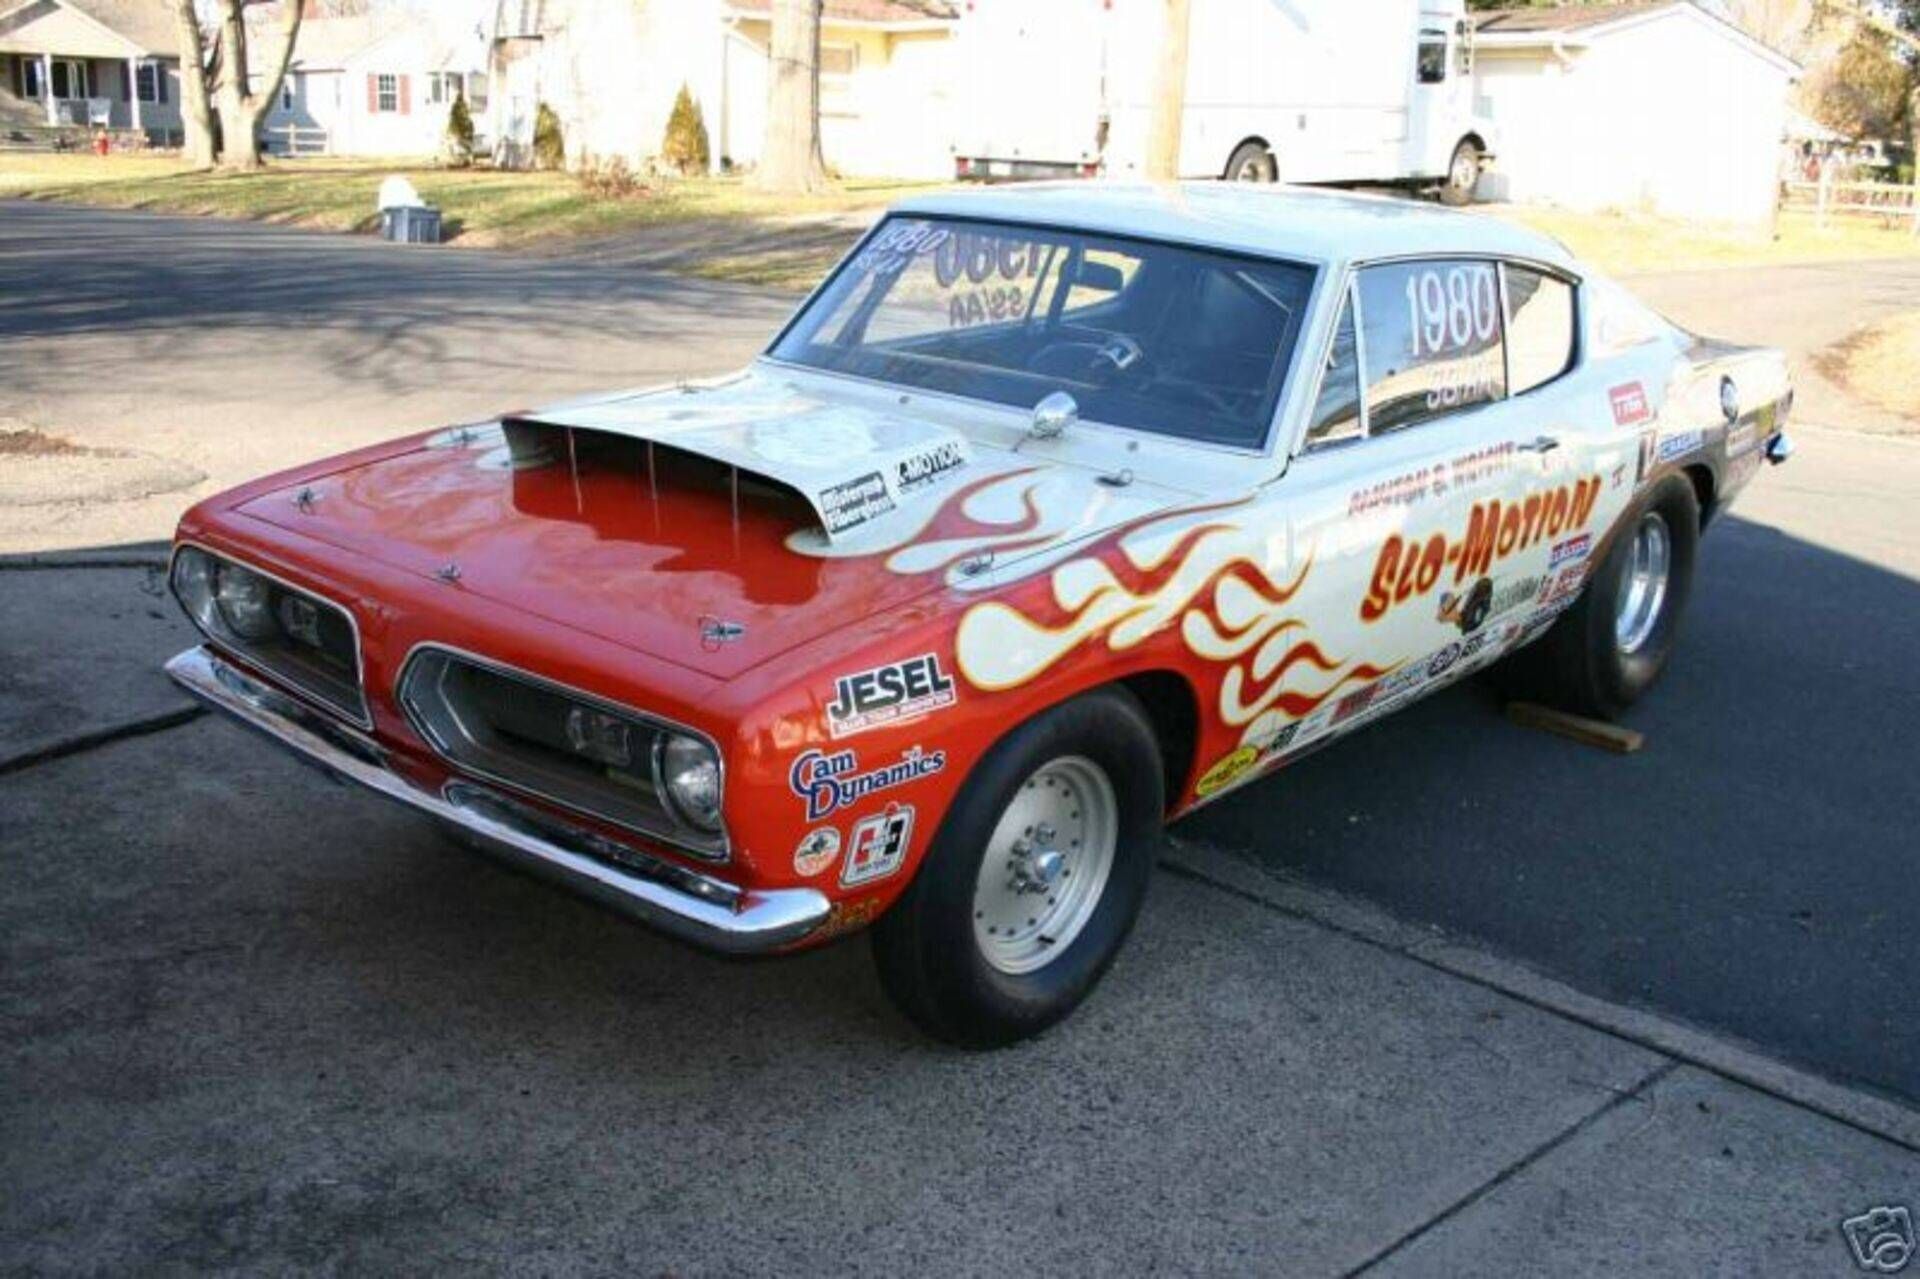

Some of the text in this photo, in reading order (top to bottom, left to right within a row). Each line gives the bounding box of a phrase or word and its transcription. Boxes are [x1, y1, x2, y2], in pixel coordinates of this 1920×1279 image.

[868, 222, 949, 254] 1980
[1406, 266, 1496, 356] 1980
[830, 656, 952, 720] JESEL
[791, 751, 855, 796] Cam
[807, 752, 945, 820] Dynamics
